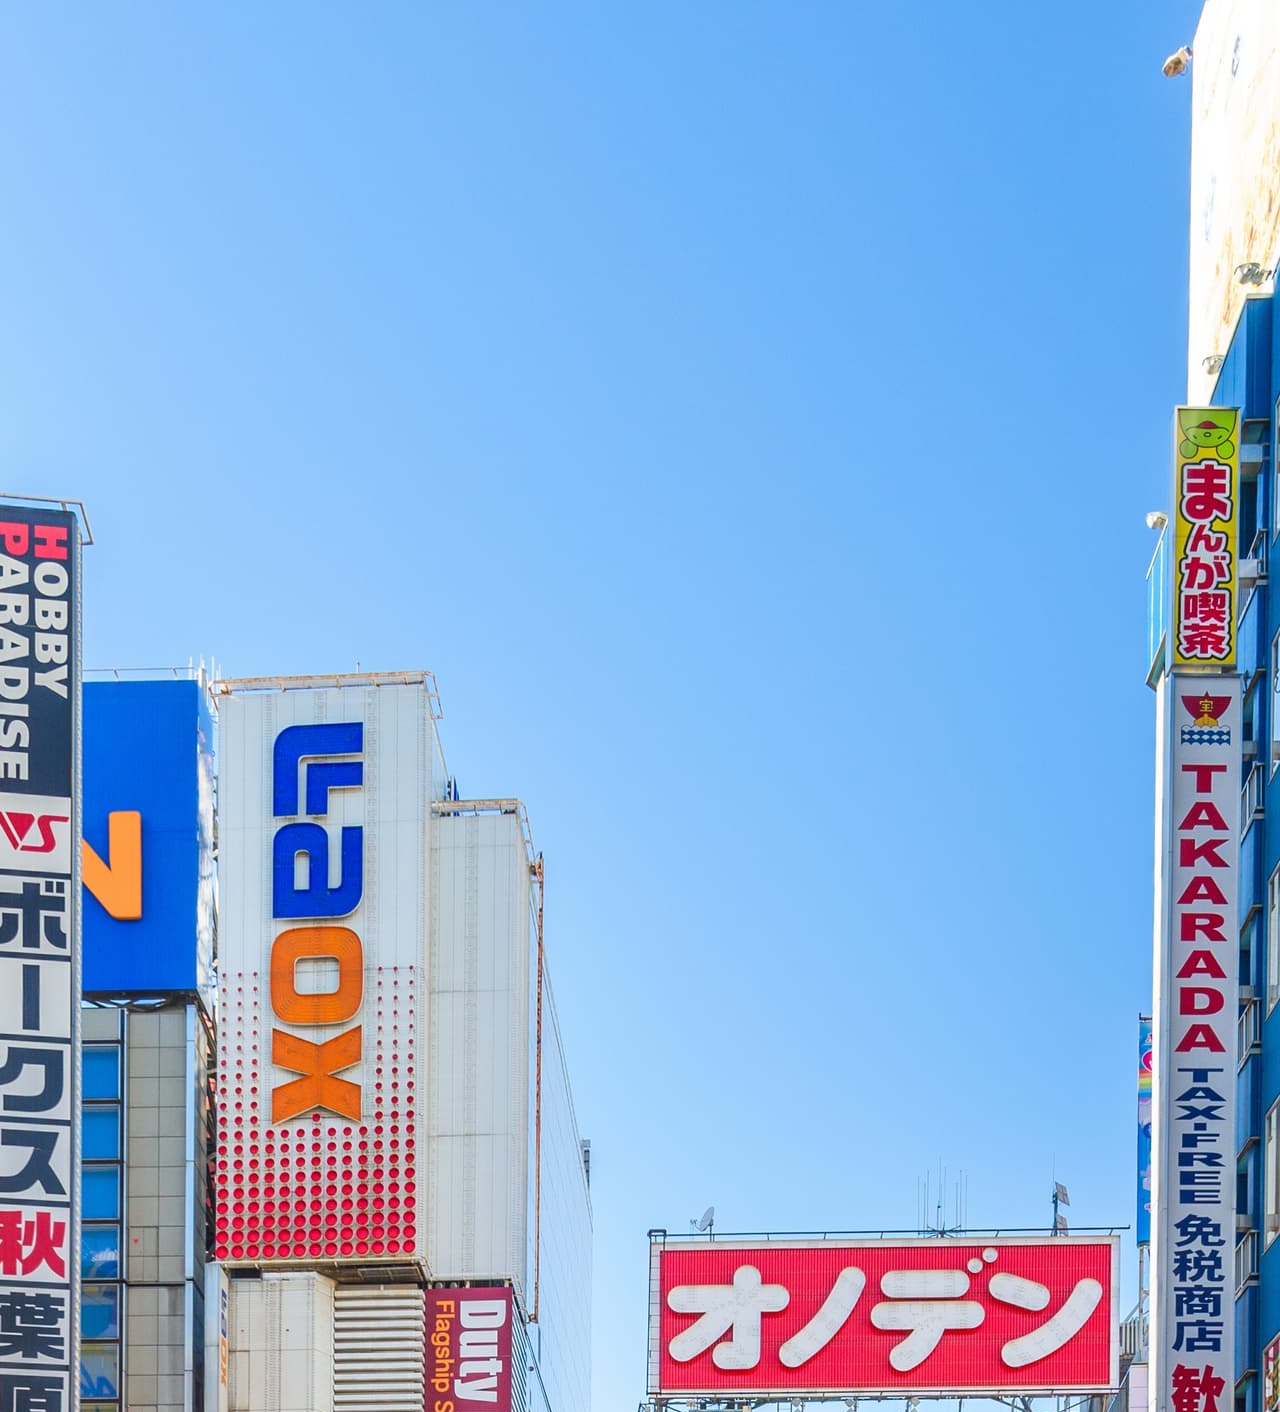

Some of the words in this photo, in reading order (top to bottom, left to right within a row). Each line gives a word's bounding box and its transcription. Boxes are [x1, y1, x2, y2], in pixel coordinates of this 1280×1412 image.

[31, 521, 69, 701] HOBBY
[1181, 462, 1229, 658] まんが喫茶
[1175, 764, 1230, 1053] TAKARADA
[431, 1300, 455, 1393] Flagship
[453, 1299, 506, 1404] Duty
[667, 1246, 1104, 1373] オノデン
[1172, 1213, 1226, 1353] 免税商店
